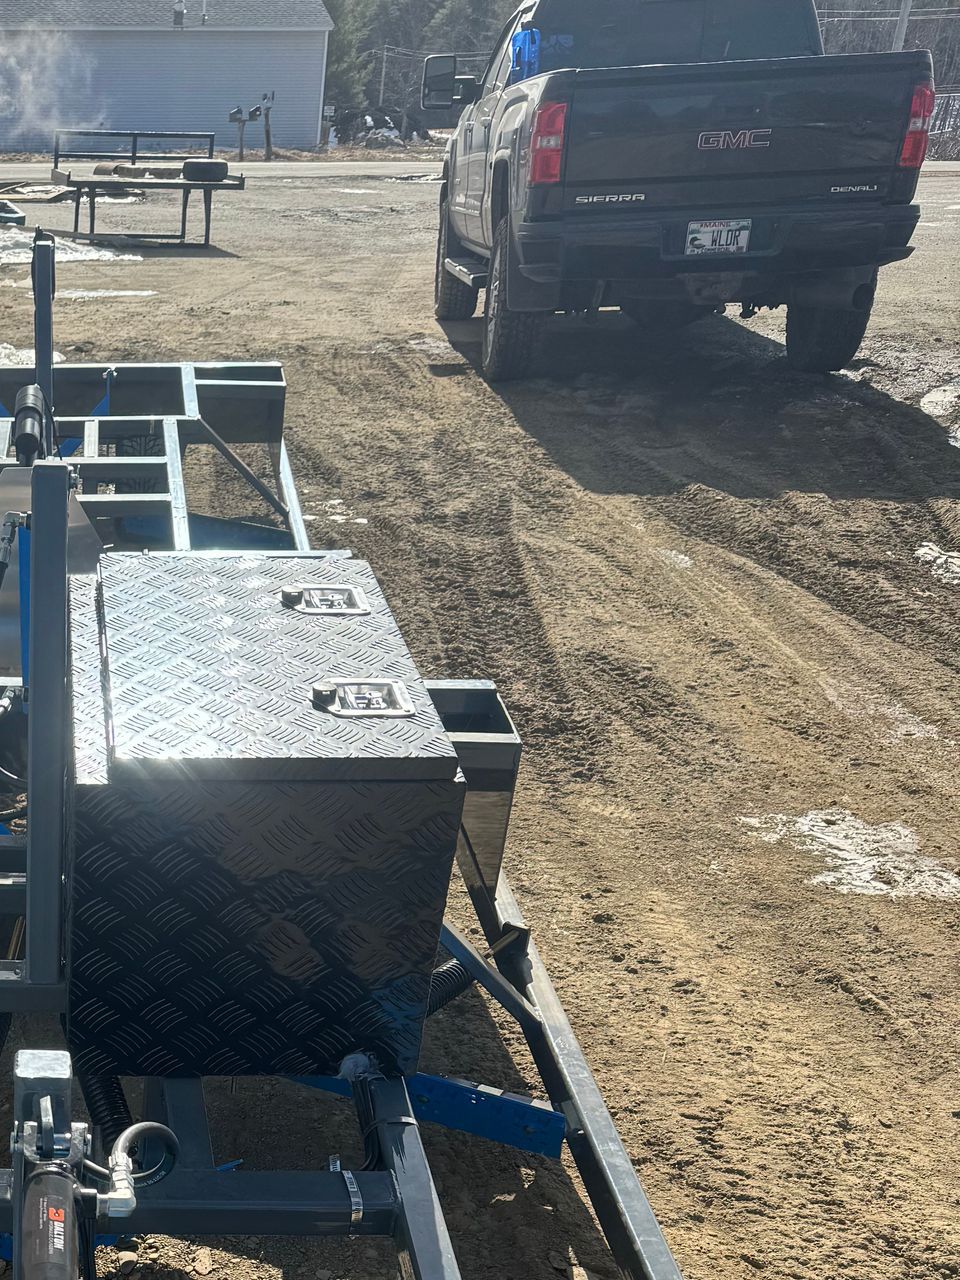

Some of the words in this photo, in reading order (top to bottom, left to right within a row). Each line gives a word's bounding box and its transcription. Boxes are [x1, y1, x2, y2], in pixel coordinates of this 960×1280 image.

[698, 129, 772, 148] GMC
[830, 184, 878, 193] DENALI
[575, 193, 645, 204] SIERRA
[711, 229, 741, 247] WLDR
[53, 1221, 65, 1250] DALTON
